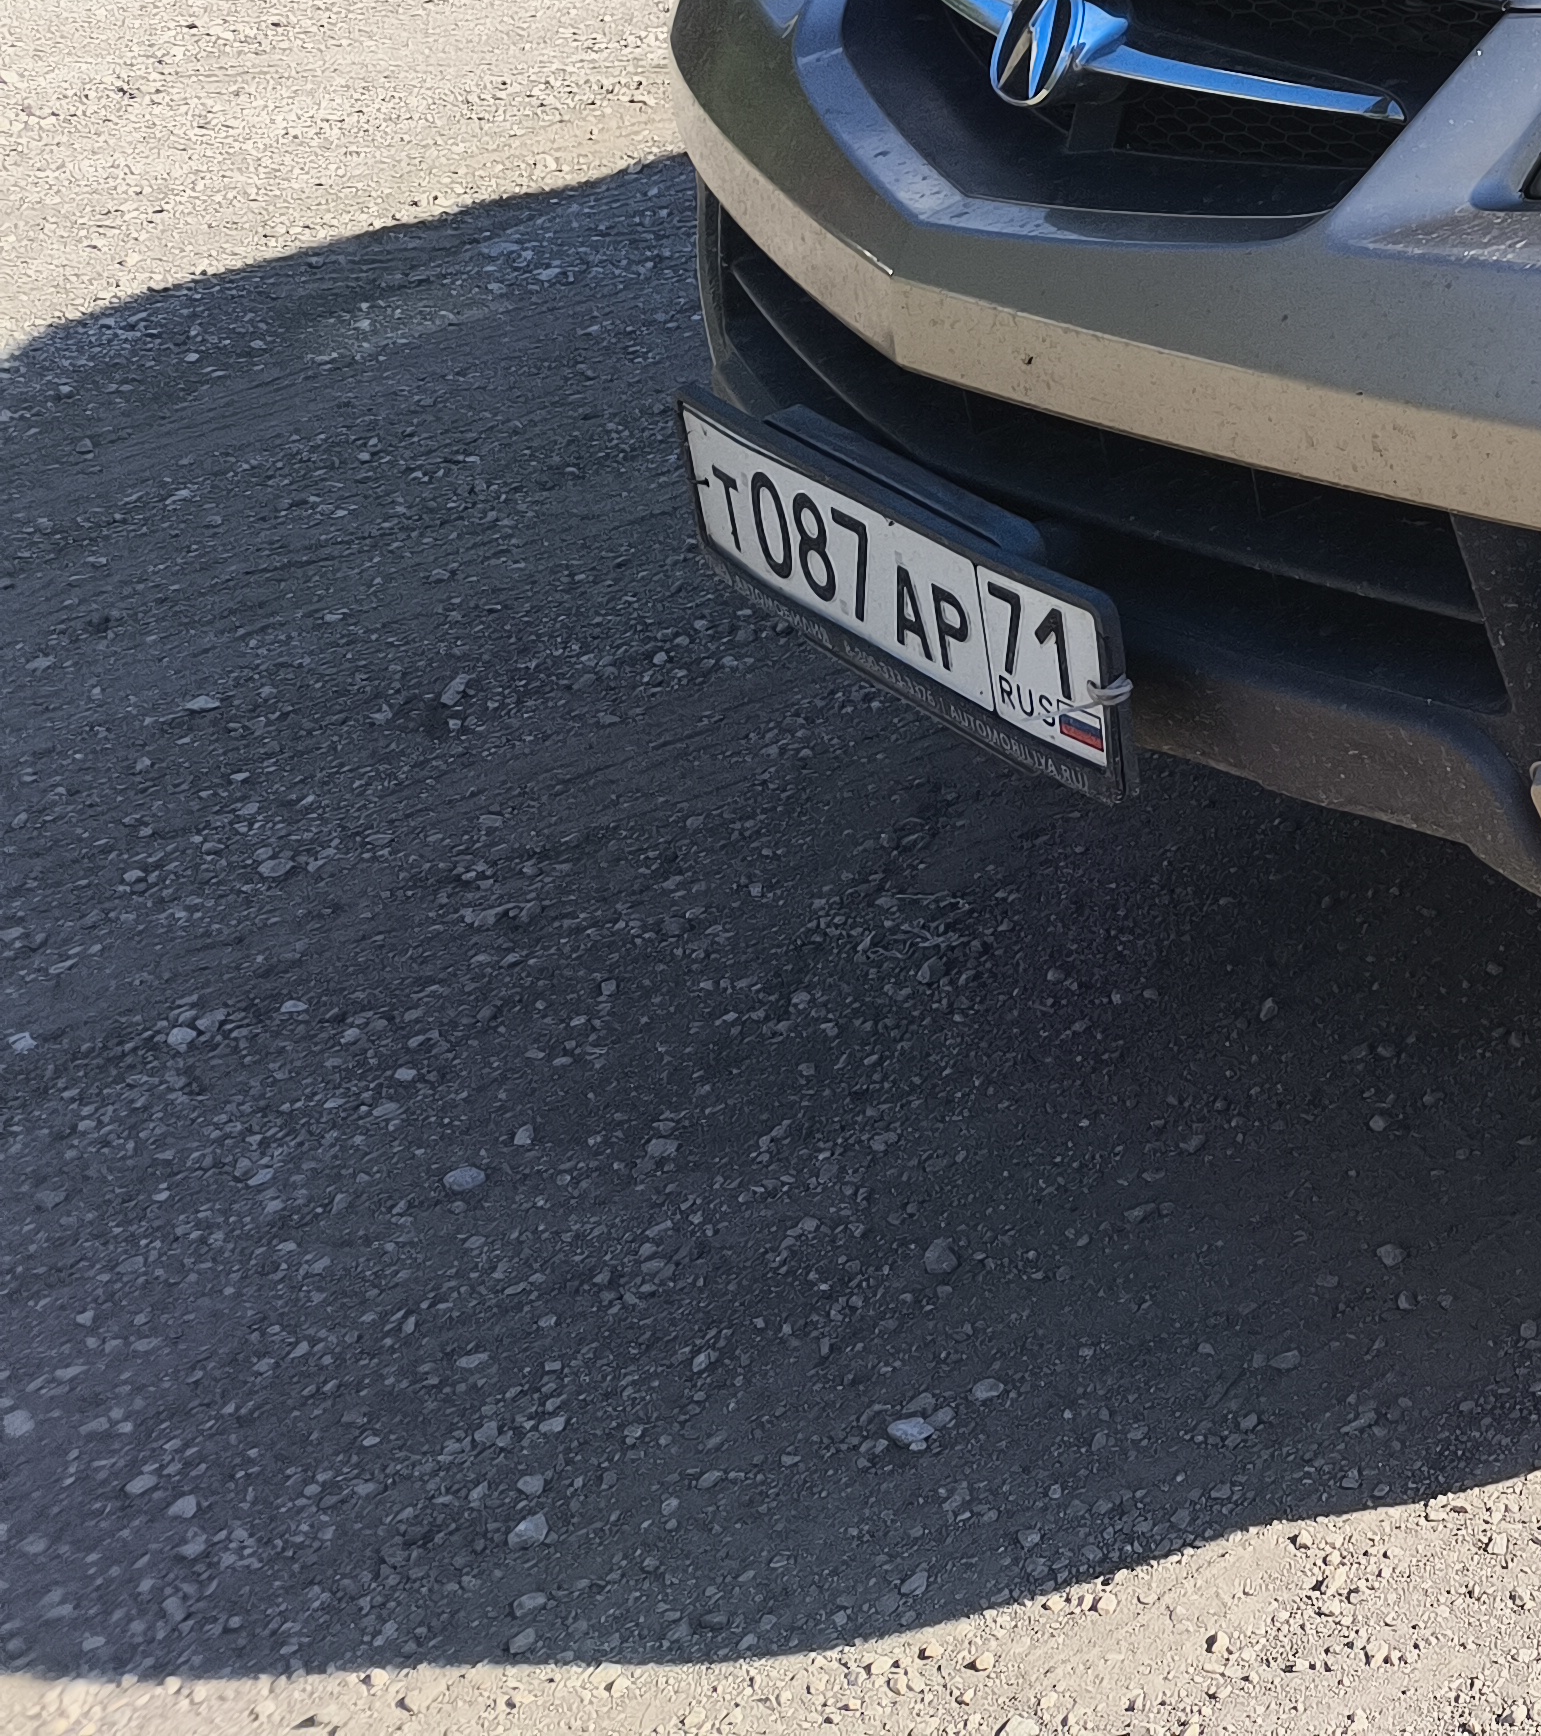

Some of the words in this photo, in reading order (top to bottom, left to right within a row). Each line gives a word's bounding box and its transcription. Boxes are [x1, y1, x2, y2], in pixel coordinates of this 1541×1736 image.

[711, 464, 970, 672] Т087АР
[987, 579, 1073, 701] 71
[999, 674, 1057, 729] RUS
